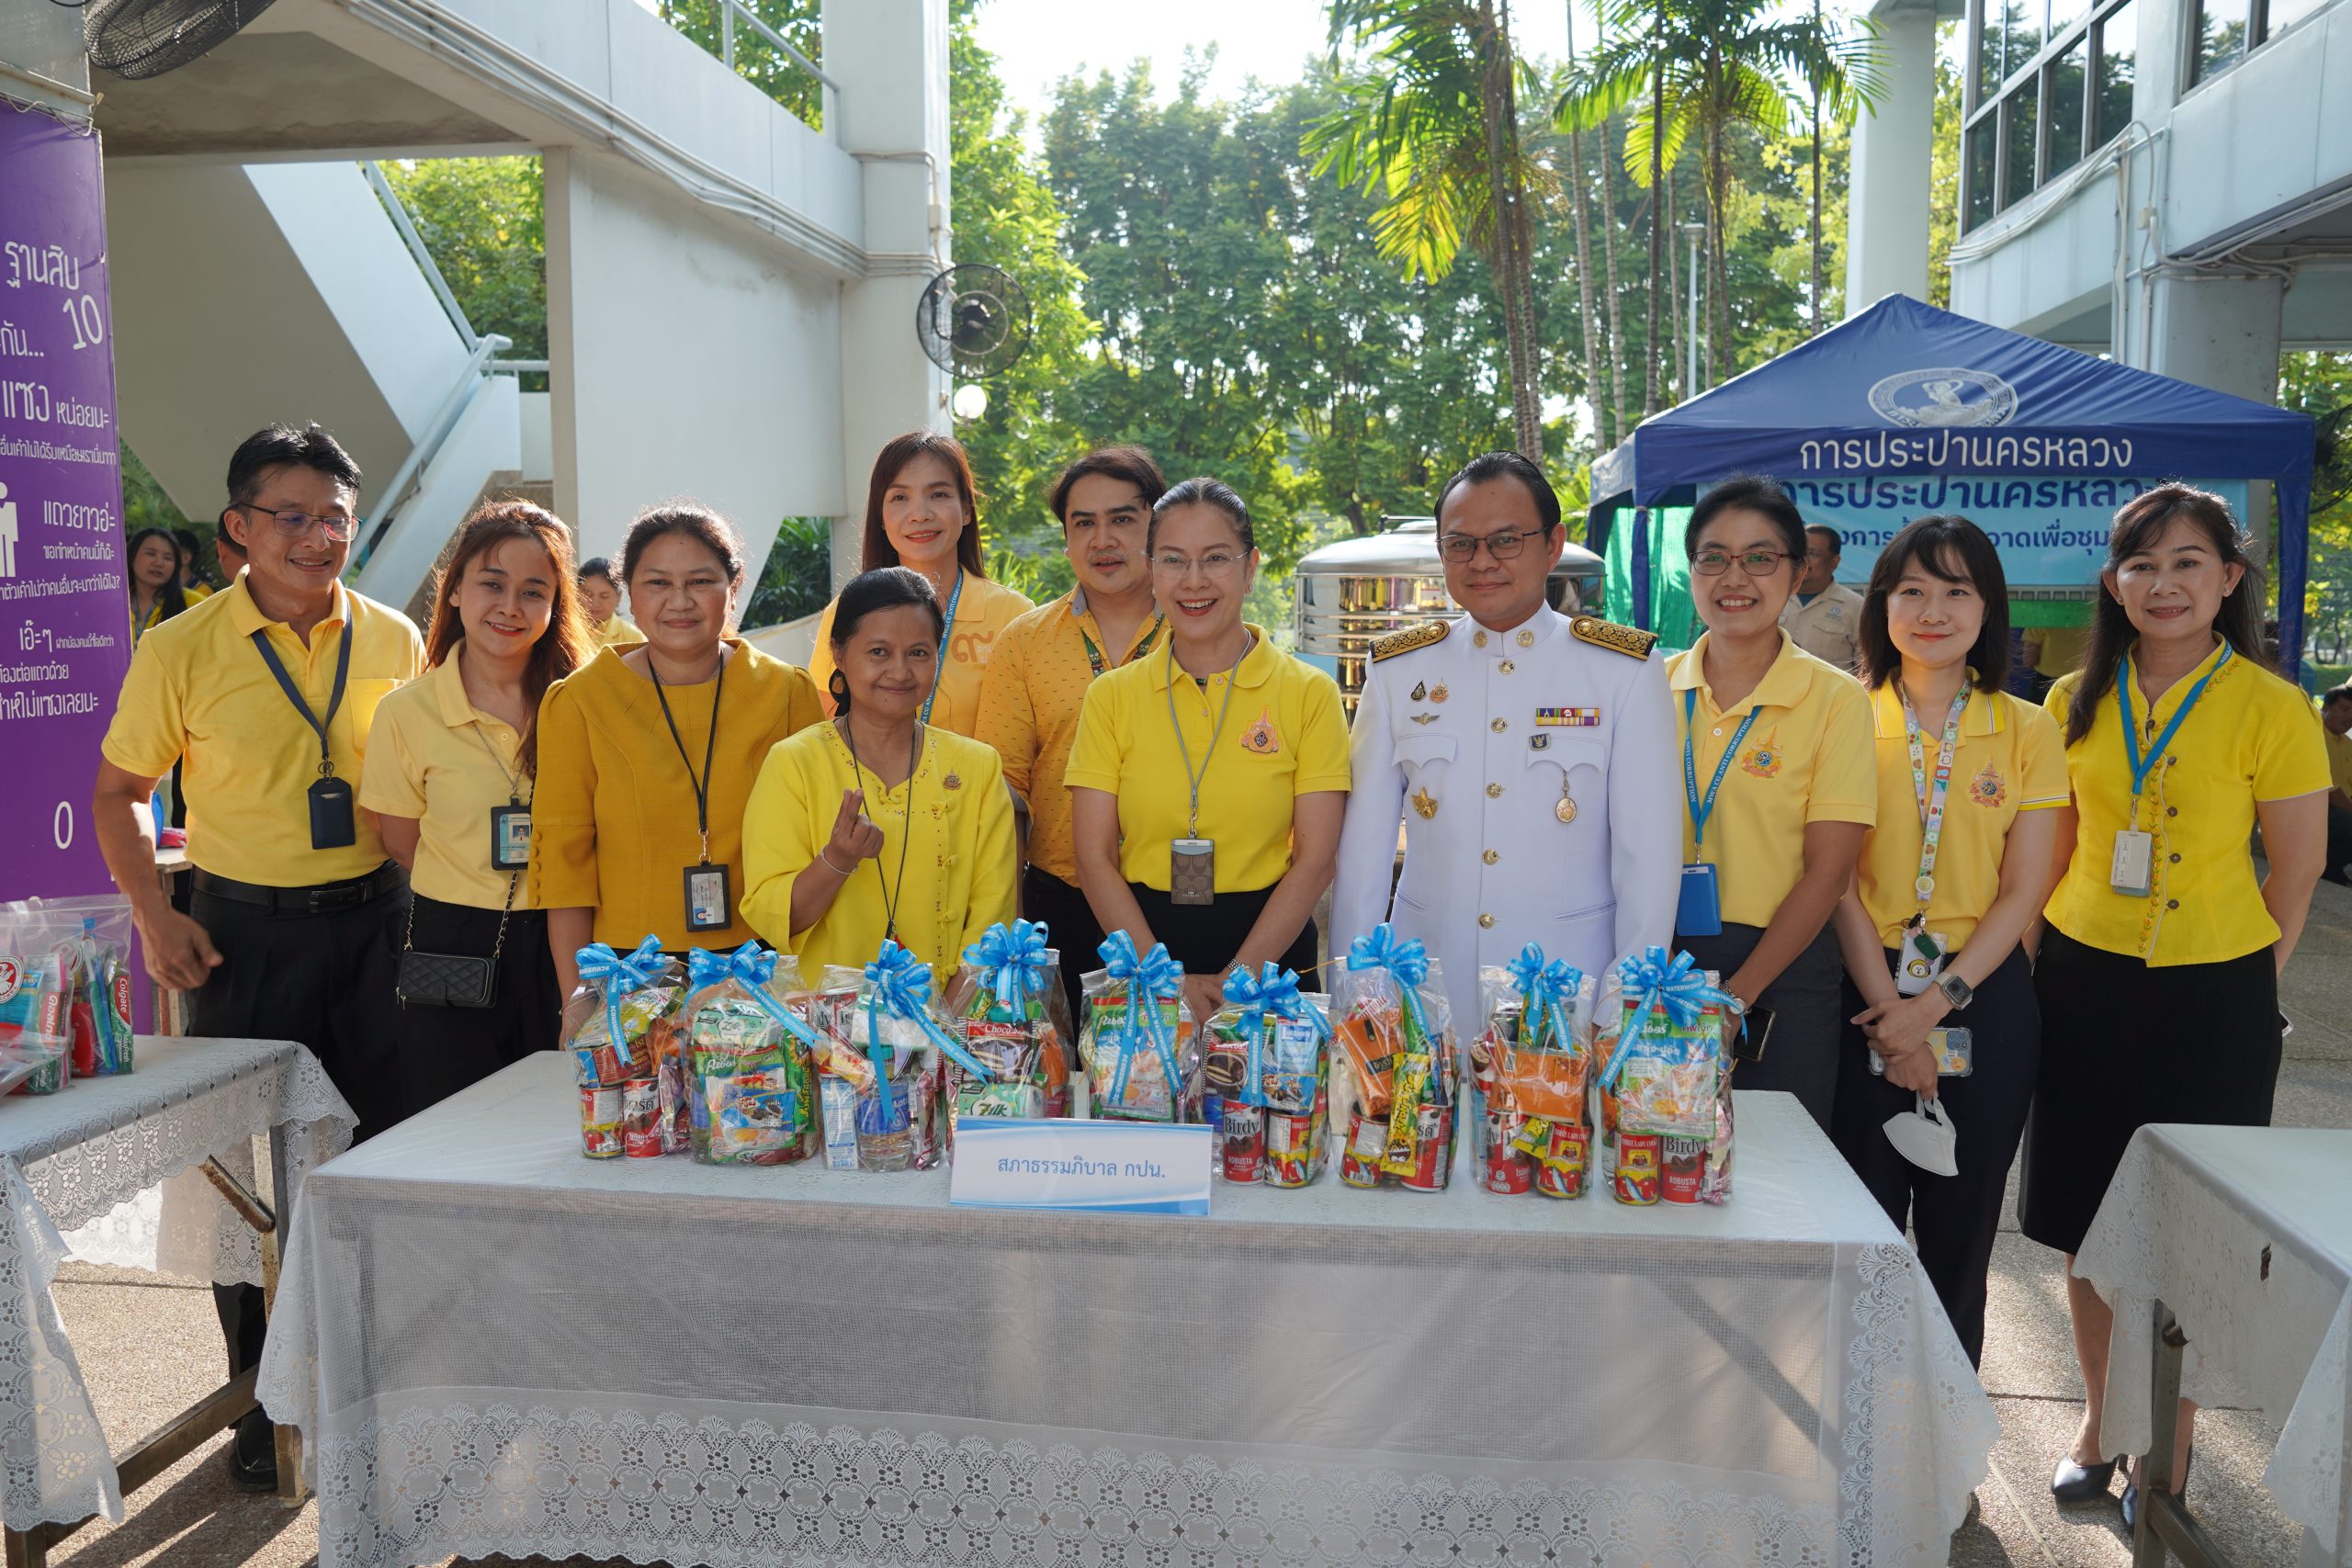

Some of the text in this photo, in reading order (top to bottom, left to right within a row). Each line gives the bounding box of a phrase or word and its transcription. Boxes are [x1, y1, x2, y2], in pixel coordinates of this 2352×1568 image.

[62, 294, 103, 350] 10
[1800, 429, 2132, 469] การประปานครหลวง
[1726, 716, 1752, 759] CORRUPTION
[119, 977, 129, 1013] Colgate
[1225, 1117, 1259, 1136] Birdy
[1666, 1136, 1702, 1154] Birdy
[998, 1156, 1166, 1179] สภาธรรมภิบาล กปน.
[1668, 1176, 1696, 1186] ROBUSTA
